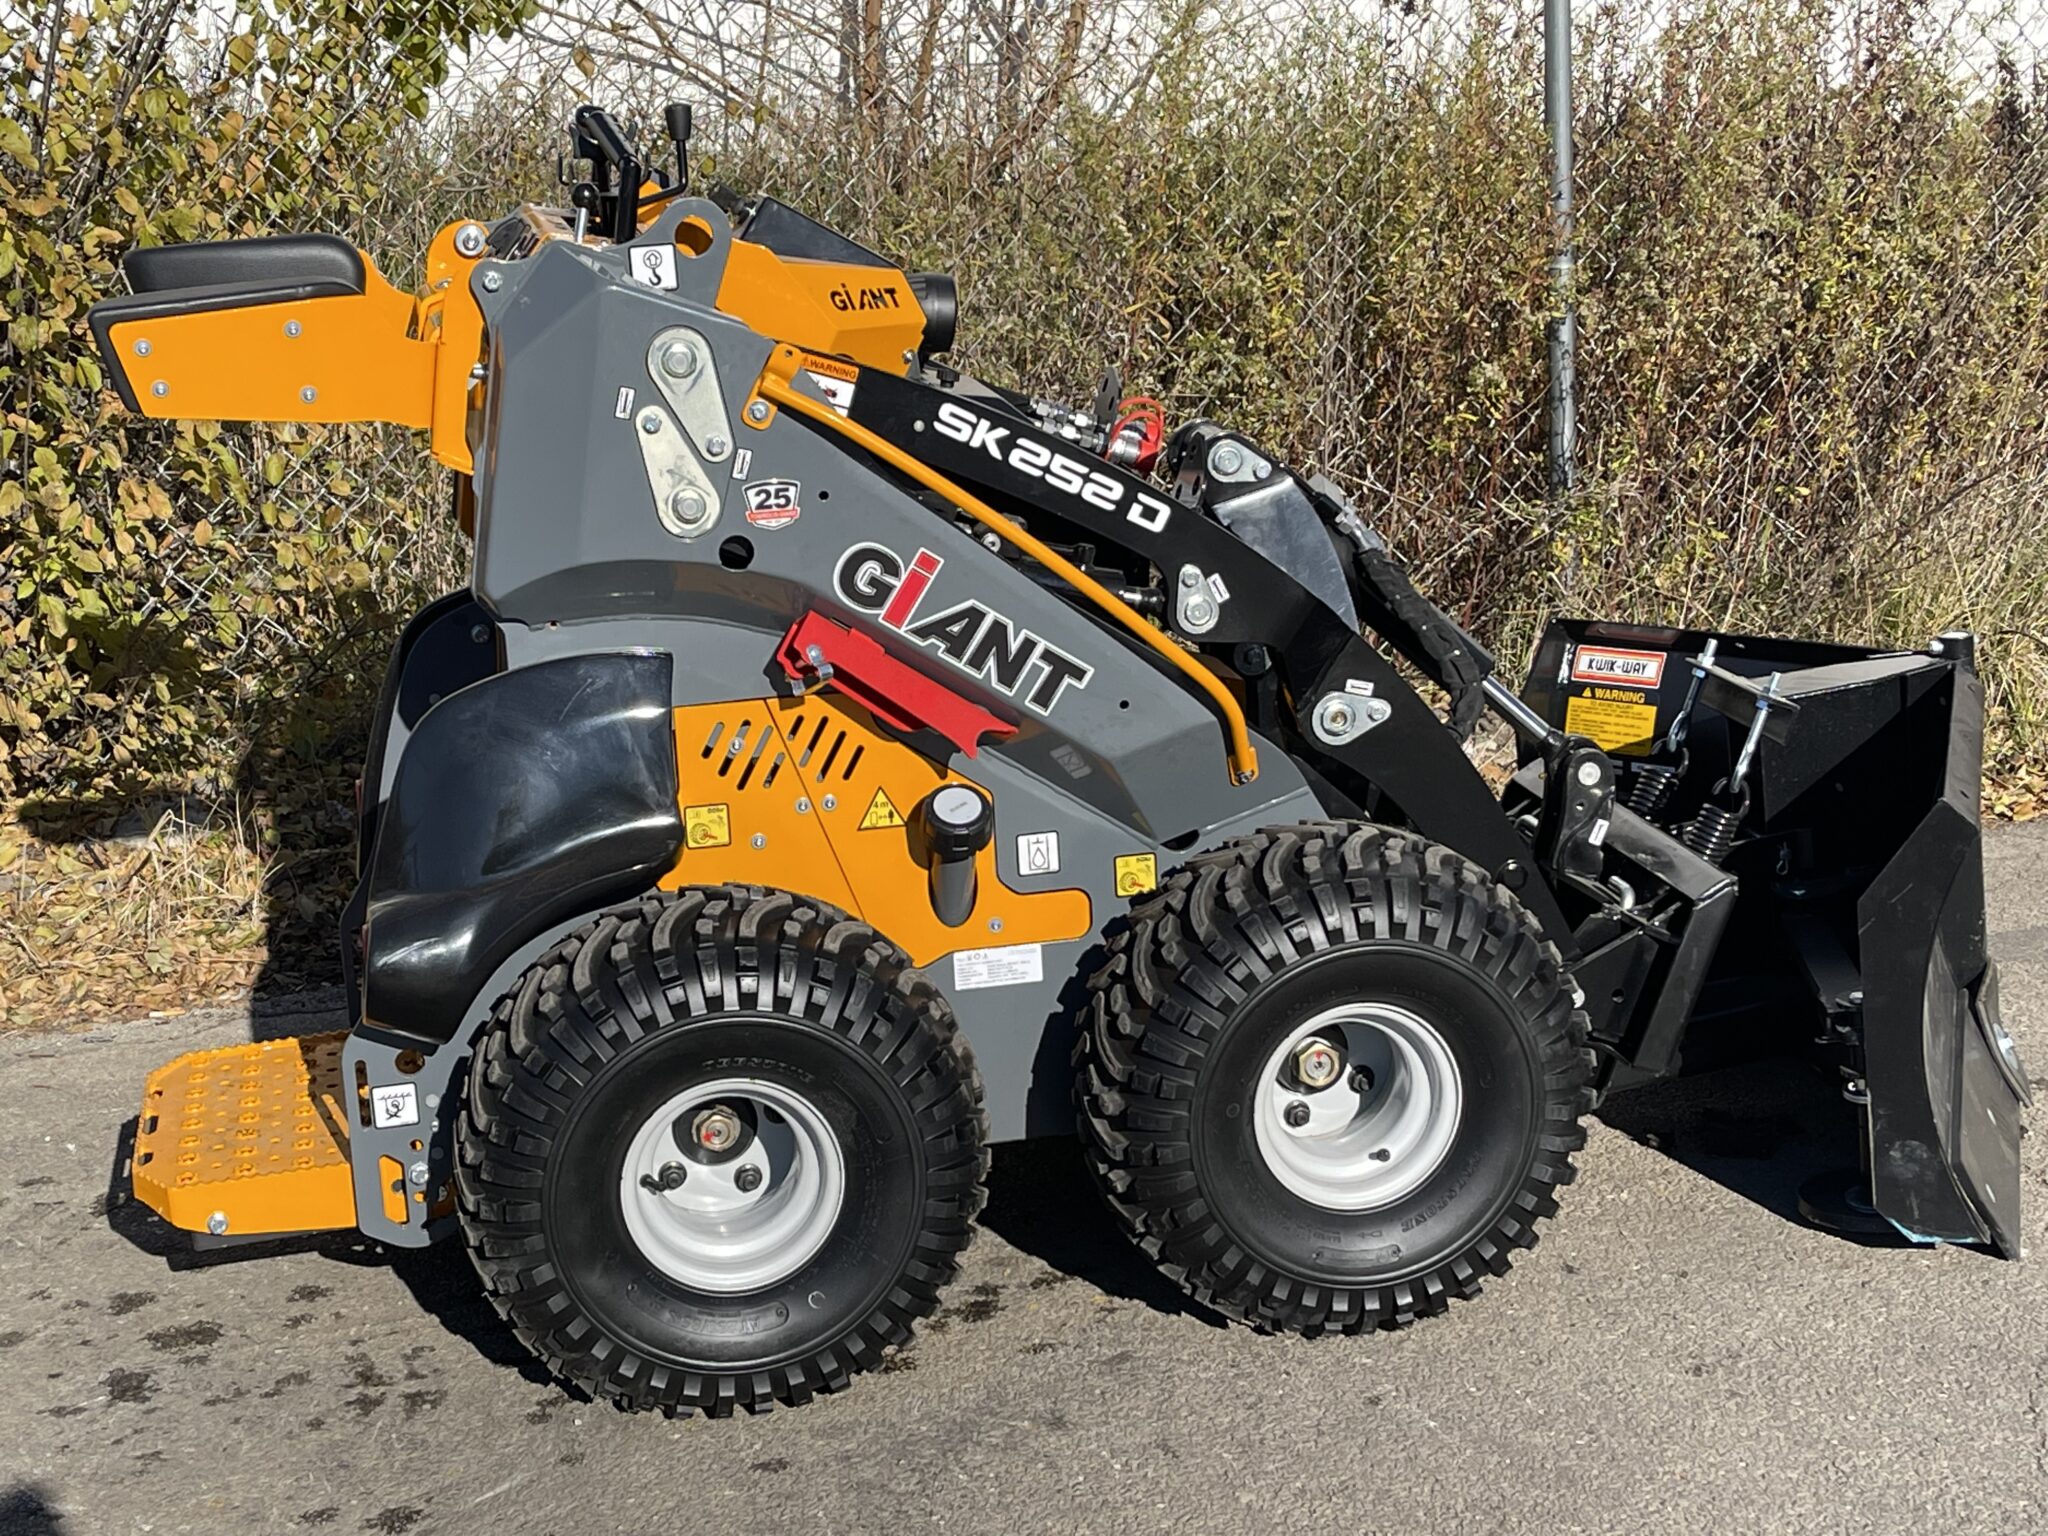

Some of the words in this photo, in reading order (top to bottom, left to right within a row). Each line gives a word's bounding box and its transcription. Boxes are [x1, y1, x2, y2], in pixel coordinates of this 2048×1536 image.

[809, 358, 857, 380] WARNING
[932, 401, 1011, 462] SK
[1007, 437, 1125, 512] 252
[1125, 491, 1172, 533] D
[754, 486, 792, 511] 25
[1586, 657, 1649, 676] KWIK-WAY
[1594, 687, 1646, 704] WARNING
